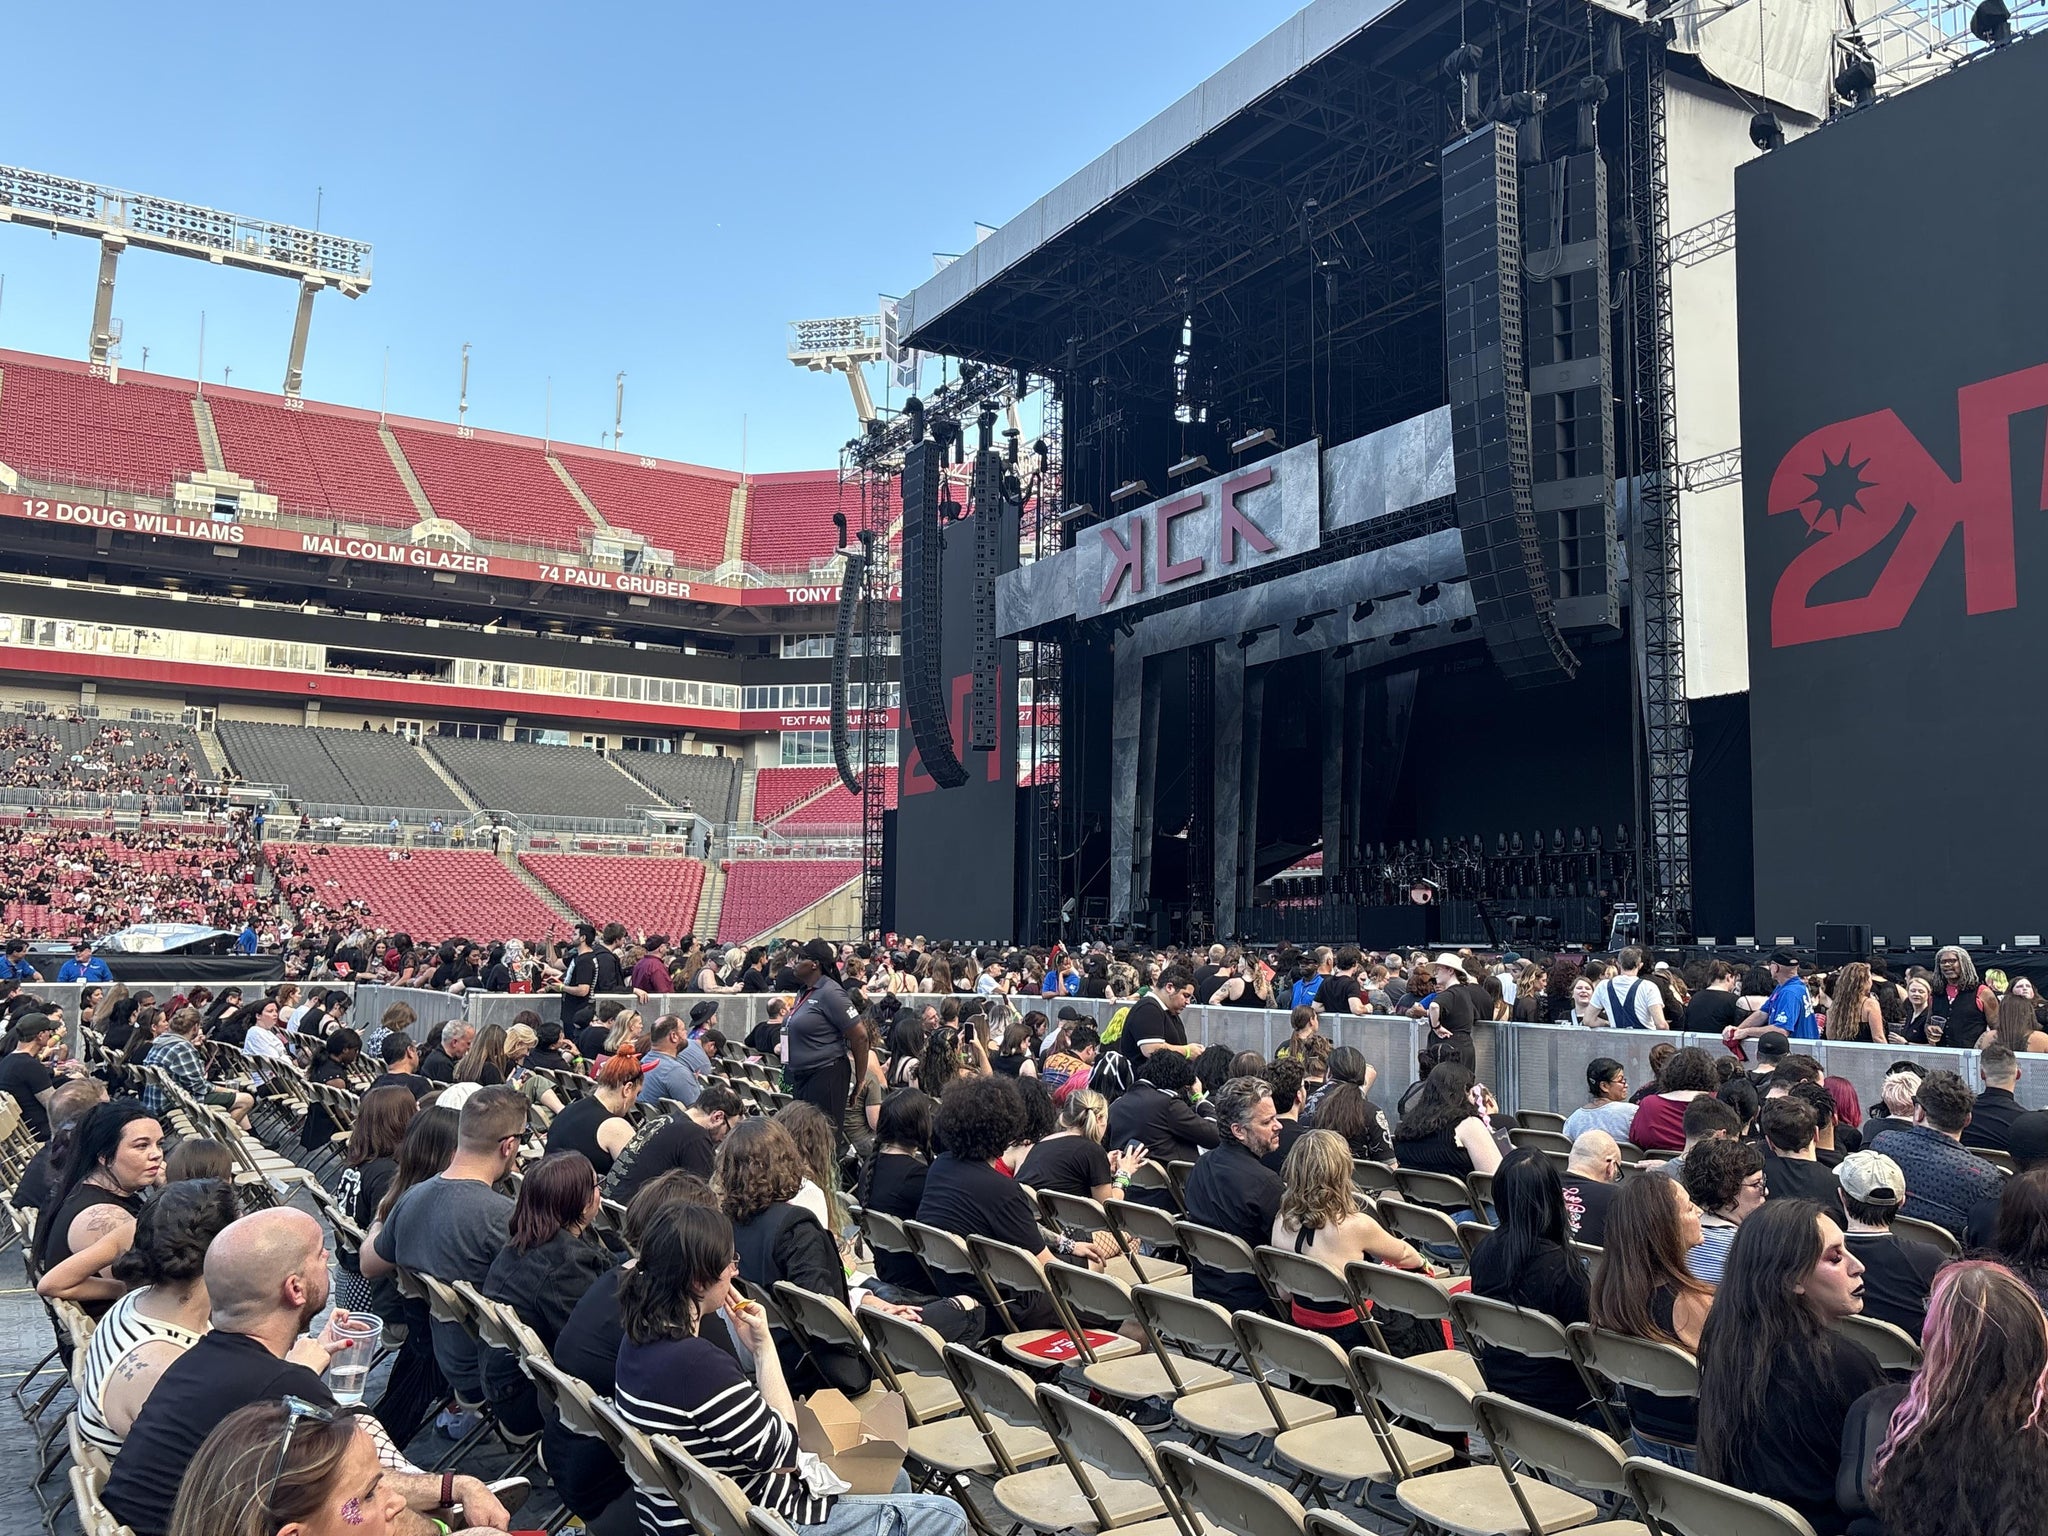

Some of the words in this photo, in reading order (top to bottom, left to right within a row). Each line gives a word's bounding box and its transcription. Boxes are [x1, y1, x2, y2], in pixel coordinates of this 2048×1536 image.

[89, 365, 110, 376] 333
[284, 398, 305, 409] 332
[457, 426, 474, 437] 331
[640, 457, 657, 467] 330
[22, 499, 50, 518] 12
[55, 503, 127, 528] DOUG
[133, 513, 245, 543] WILLIAMS
[302, 534, 405, 562] MALCOLM
[410, 548, 489, 573] GLAZER
[538, 565, 560, 581] 74
[564, 568, 612, 588] PAUL
[616, 575, 691, 598] GRUBER
[786, 587, 831, 602] TONY
[780, 715, 807, 726] TEXT
[809, 714, 831, 725] FAN
